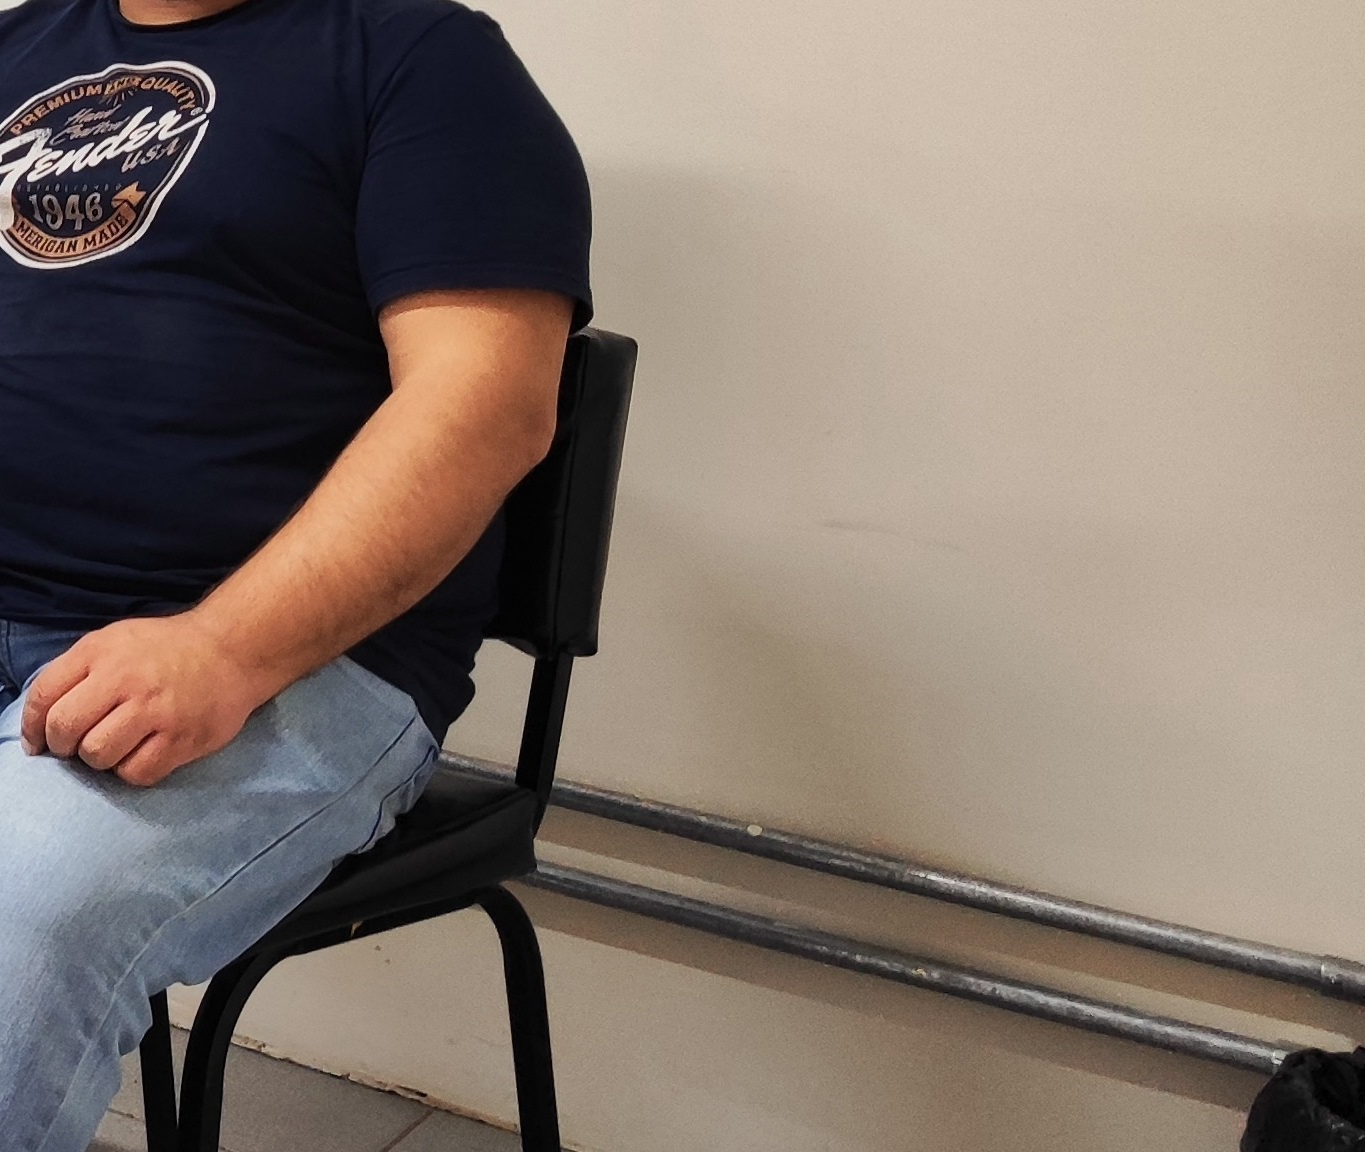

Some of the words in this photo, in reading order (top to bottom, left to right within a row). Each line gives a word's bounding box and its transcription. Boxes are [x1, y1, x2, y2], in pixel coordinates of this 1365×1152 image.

[10, 83, 103, 135] PREMIUM
[140, 76, 196, 111] QUALITY
[121, 136, 179, 173] USA
[28, 192, 103, 231] 1946
[83, 212, 129, 251] MADE
